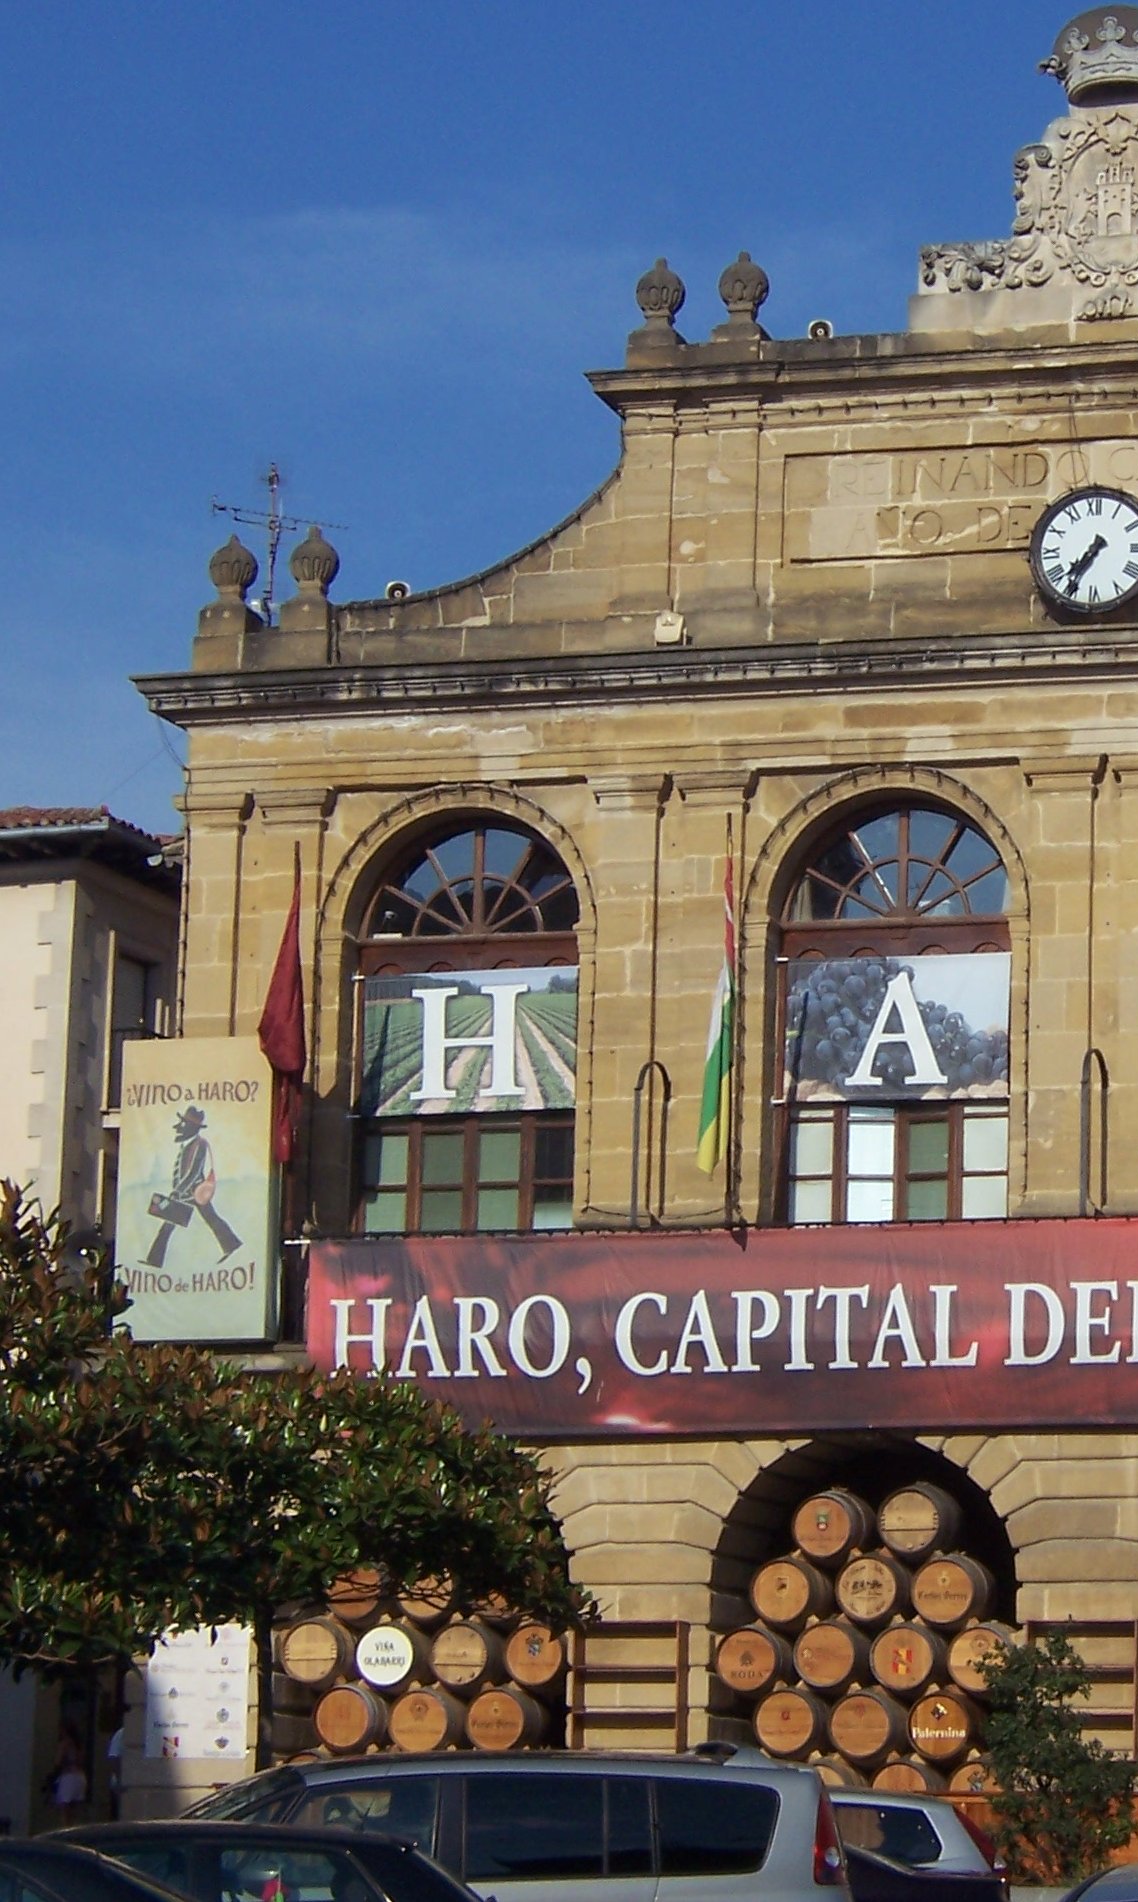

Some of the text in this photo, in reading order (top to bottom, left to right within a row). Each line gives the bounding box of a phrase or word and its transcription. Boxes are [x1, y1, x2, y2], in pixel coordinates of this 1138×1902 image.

[976, 505, 1032, 543] DE
[410, 984, 529, 1101] H
[844, 972, 948, 1086] A
[184, 1089, 195, 1101] a
[198, 1080, 259, 1102] HARO?
[175, 1276, 189, 1293] de
[191, 1261, 257, 1294] HARO!
[329, 1293, 594, 1396] HARO,
[615, 1283, 979, 1378] CAPITAL
[375, 1640, 395, 1652] VIÑA
[912, 1727, 966, 1739] Paternina
